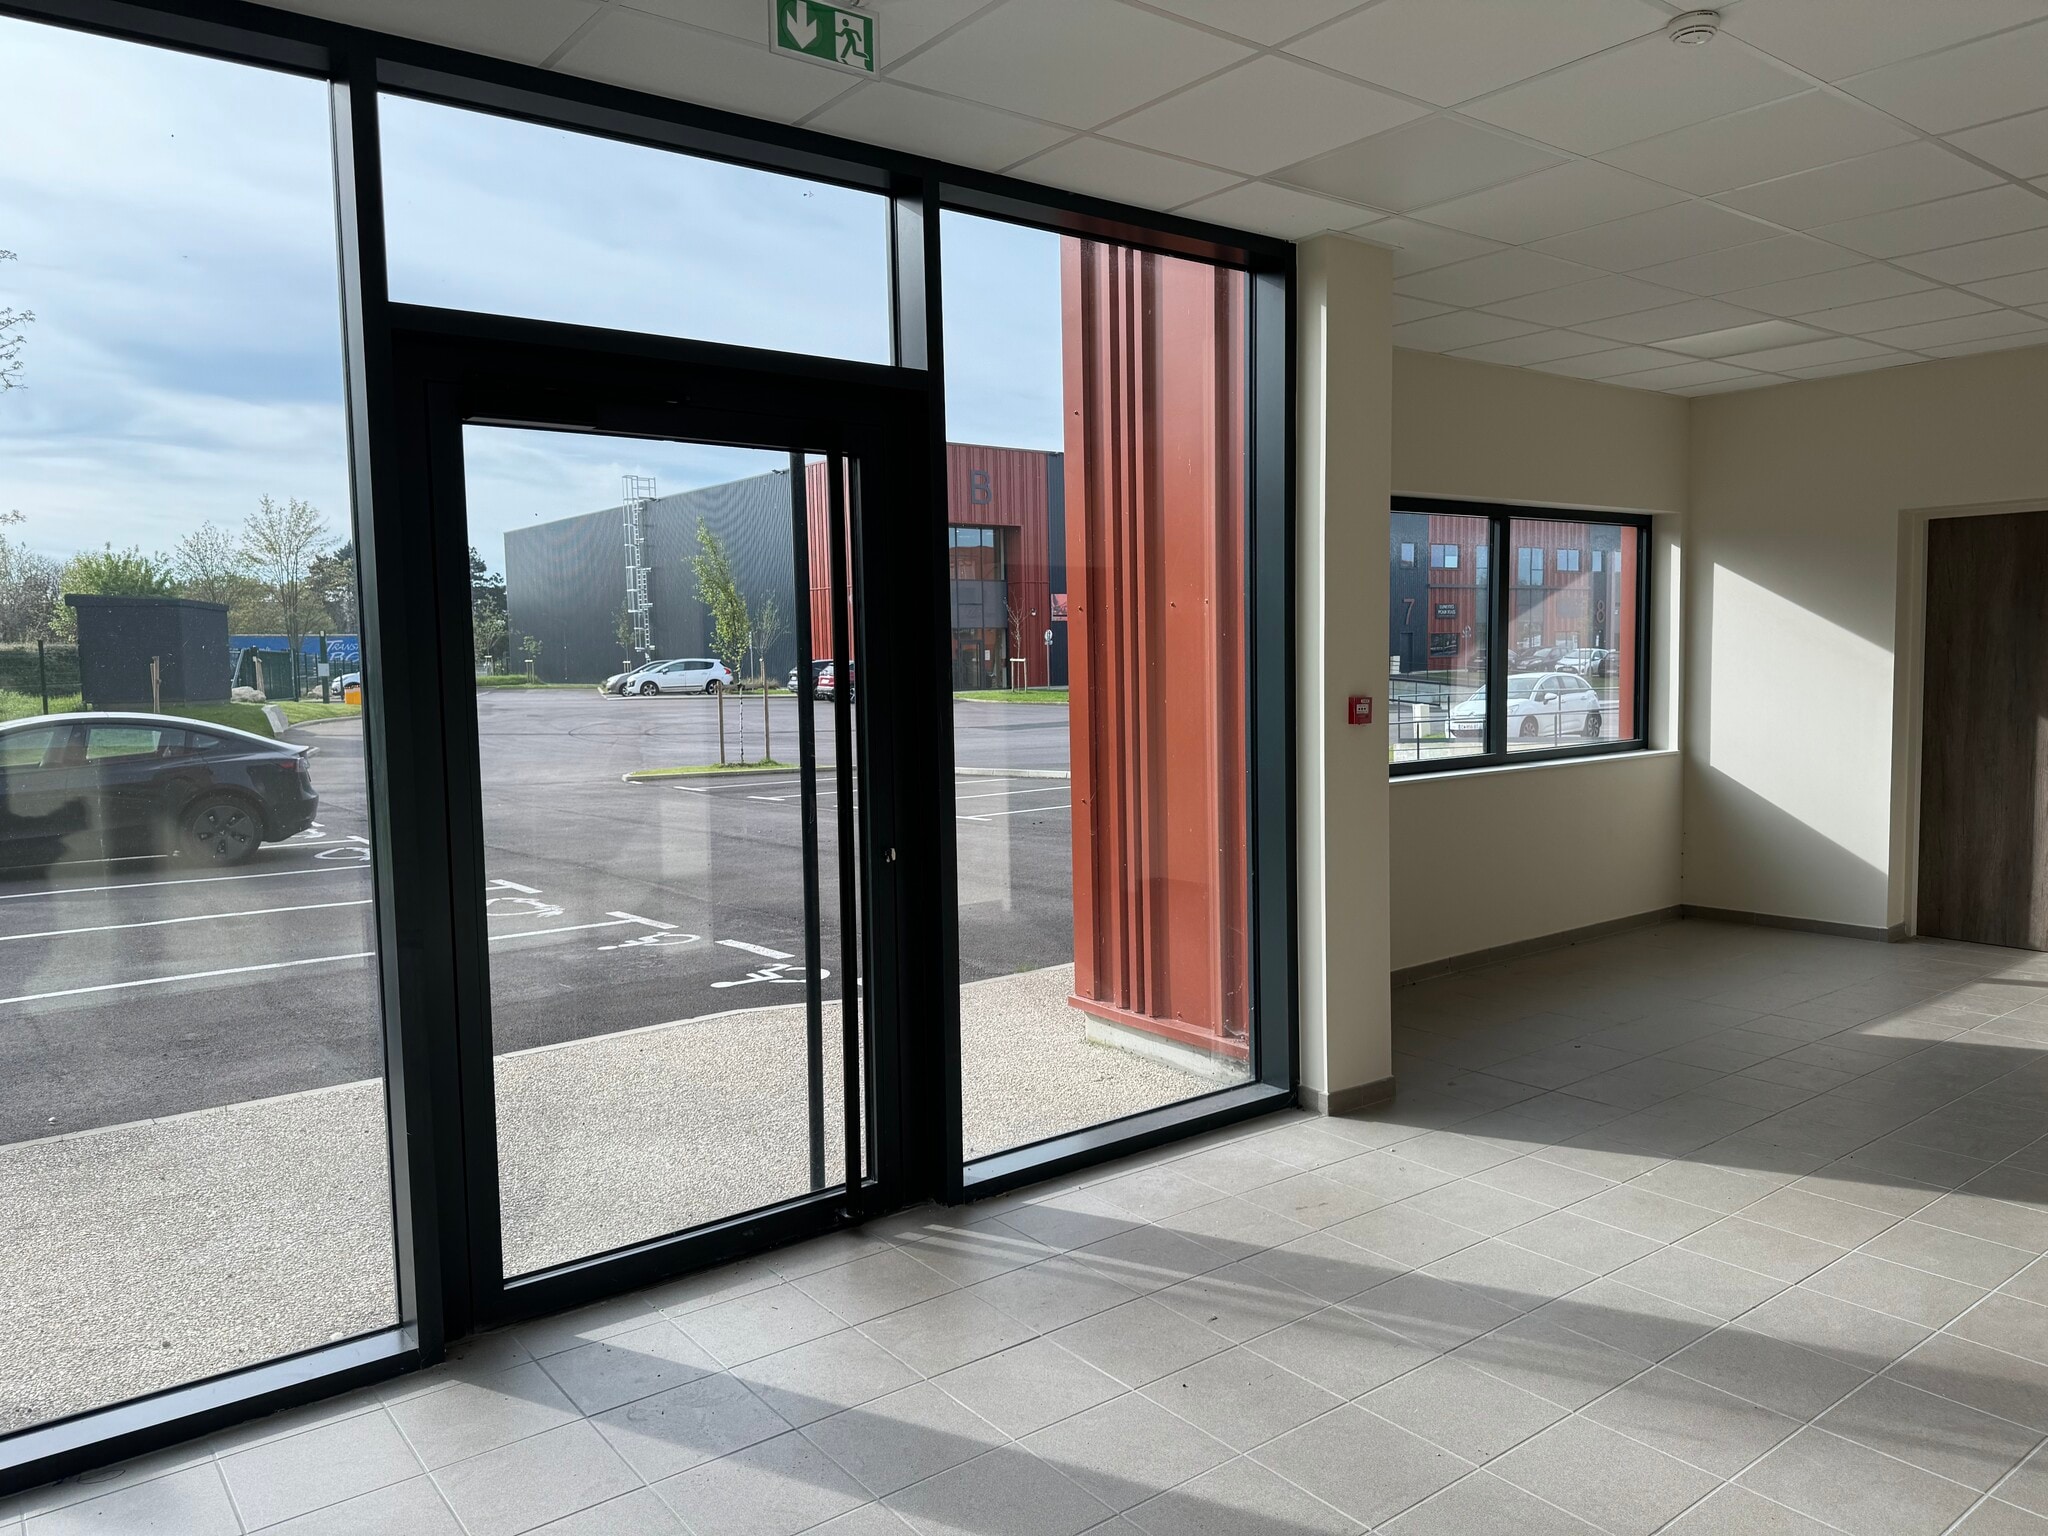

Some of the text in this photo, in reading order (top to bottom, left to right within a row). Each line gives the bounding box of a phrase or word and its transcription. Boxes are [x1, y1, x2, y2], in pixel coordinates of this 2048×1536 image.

[970, 469, 992, 505] B
[1403, 598, 1415, 625] 7
[1597, 600, 1605, 624] 8
